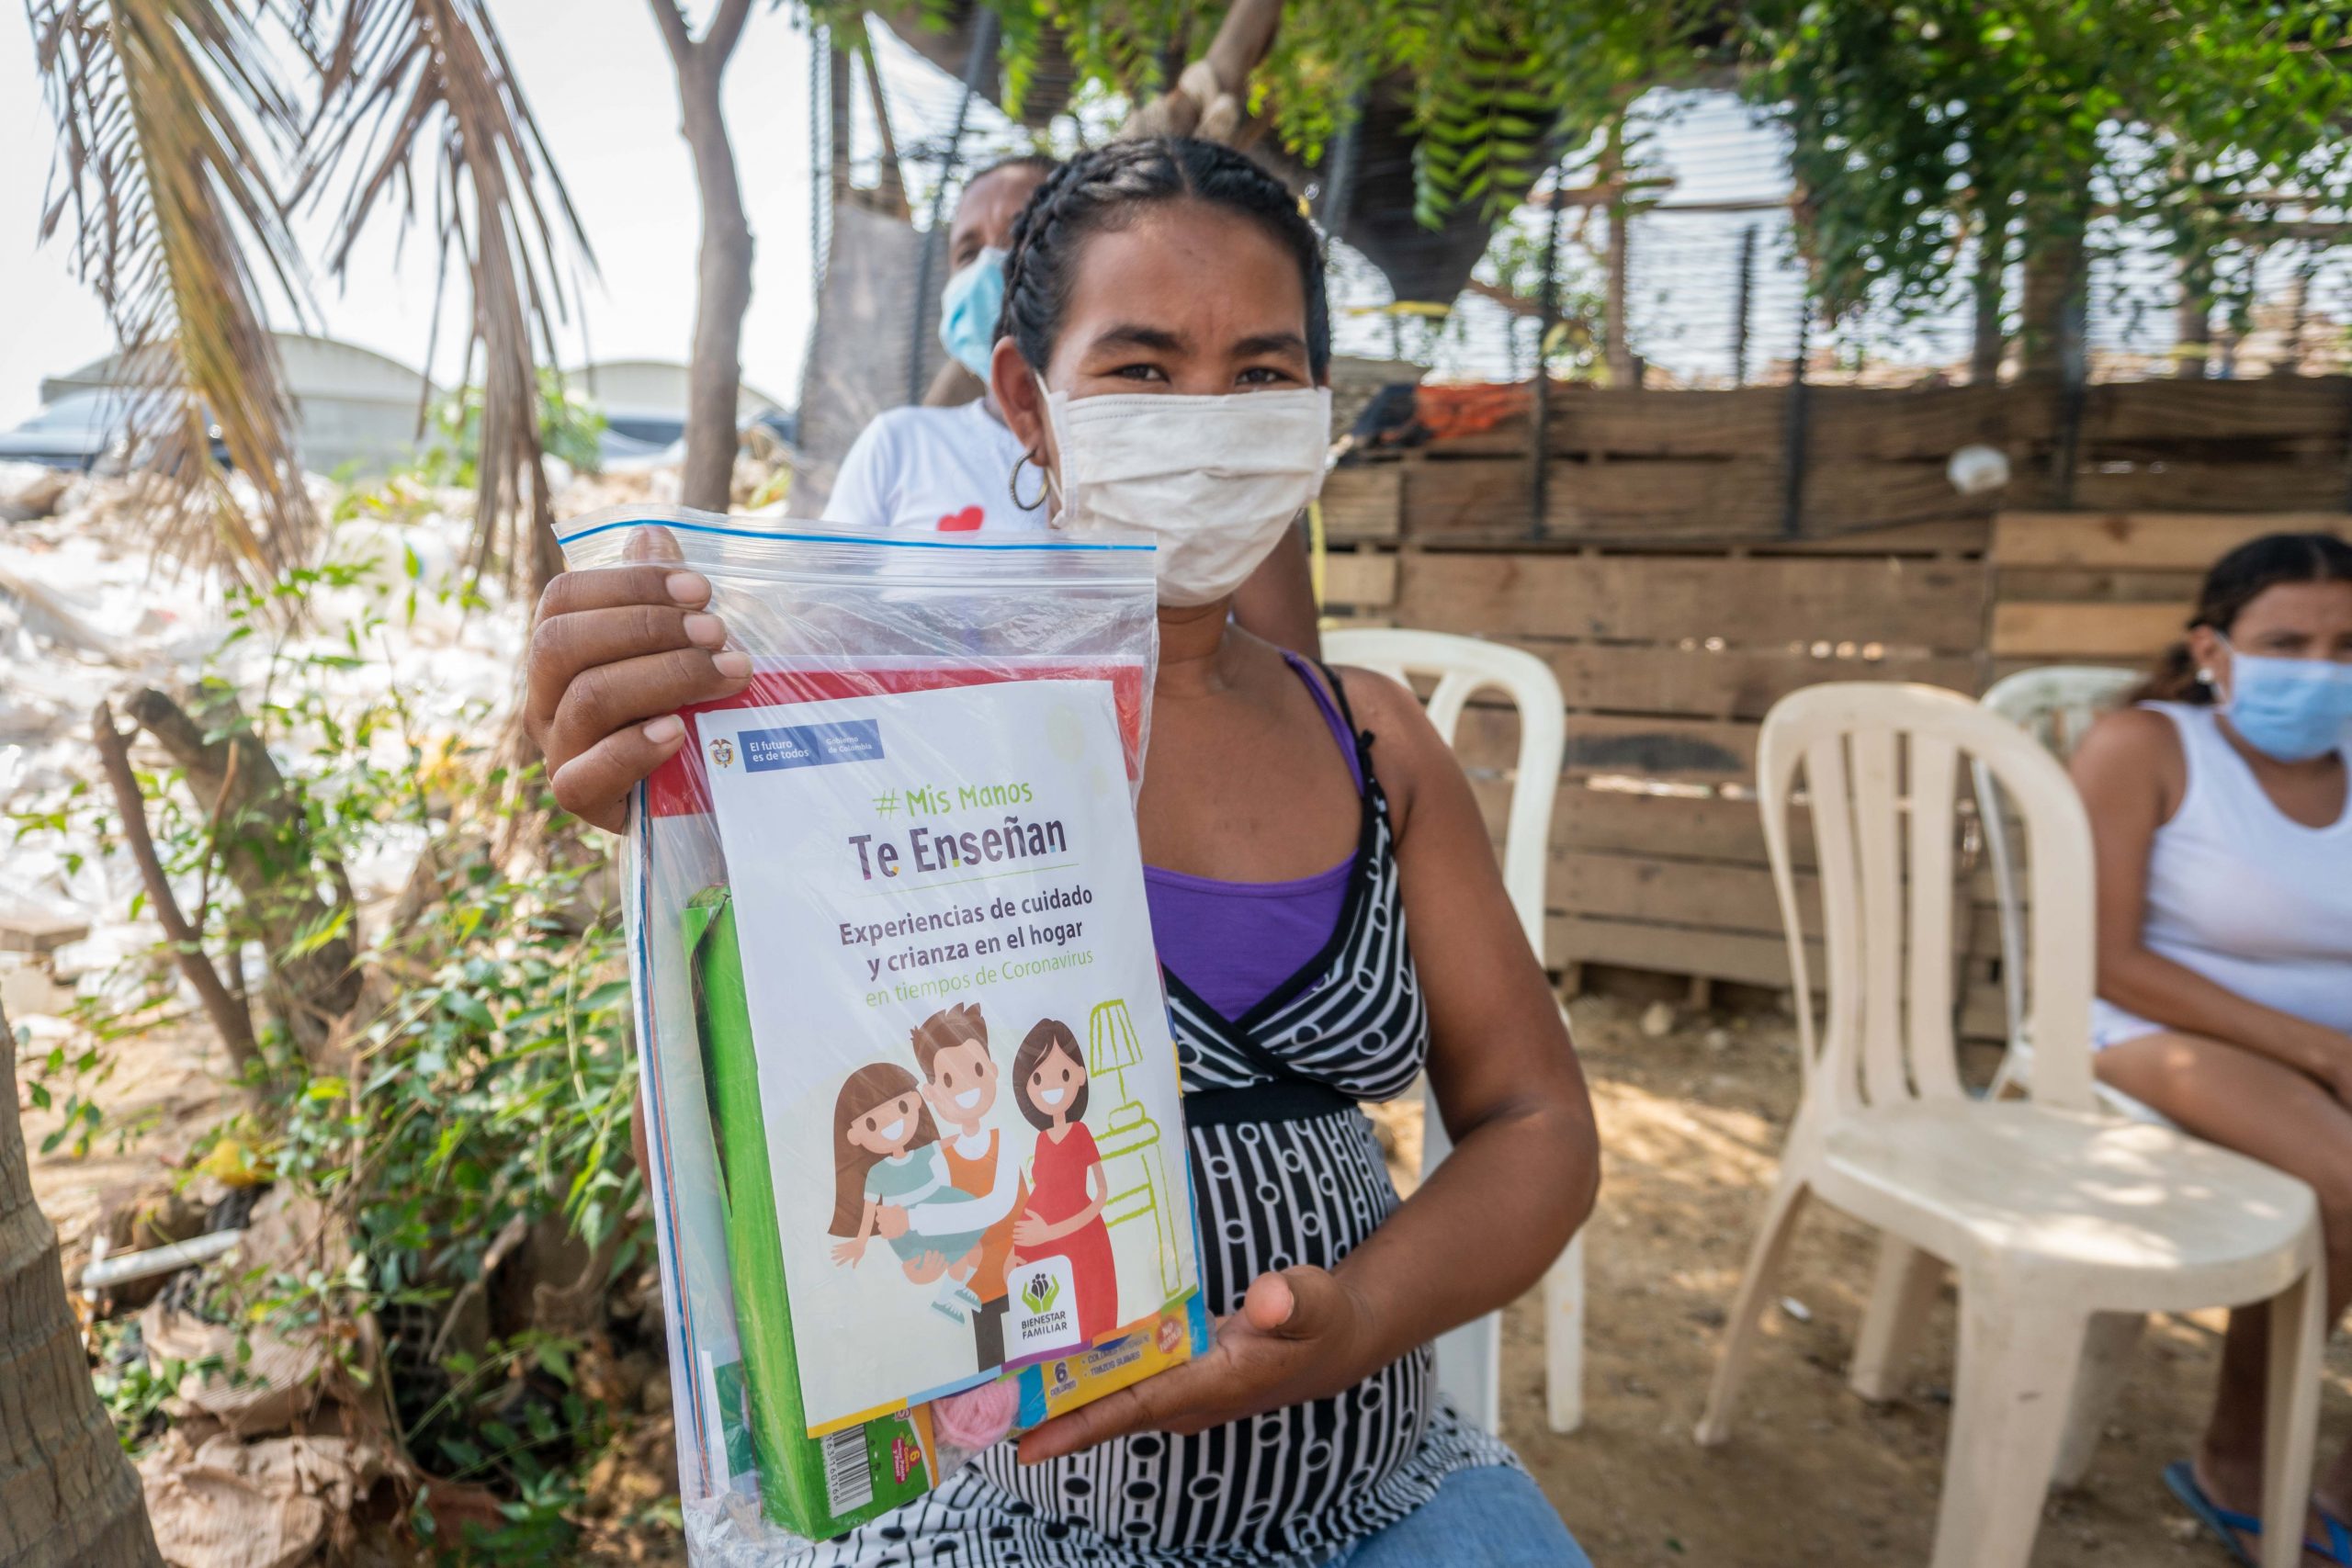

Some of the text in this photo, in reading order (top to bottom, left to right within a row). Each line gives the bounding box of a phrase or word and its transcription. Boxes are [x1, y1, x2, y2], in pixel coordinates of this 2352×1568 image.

[750, 740, 793, 752] El futuro
[827, 737, 858, 745] Gobierno
[839, 744, 872, 752] Colombia
[752, 749, 809, 762] es de todos
[958, 783, 1033, 810] Manos
[848, 816, 1068, 881] Te Enseñan
[839, 885, 1092, 947] Experiencias de cuidado
[866, 919, 1083, 982] y crianza en el hogar
[865, 949, 1093, 1008] en tiempos de Coronavirus
[1021, 1311, 1066, 1330] BIENESTAR
[1022, 1322, 1068, 1339] FAMILIAR
[1055, 1361, 1069, 1383] 6
[910, 1450, 921, 1461] 6
